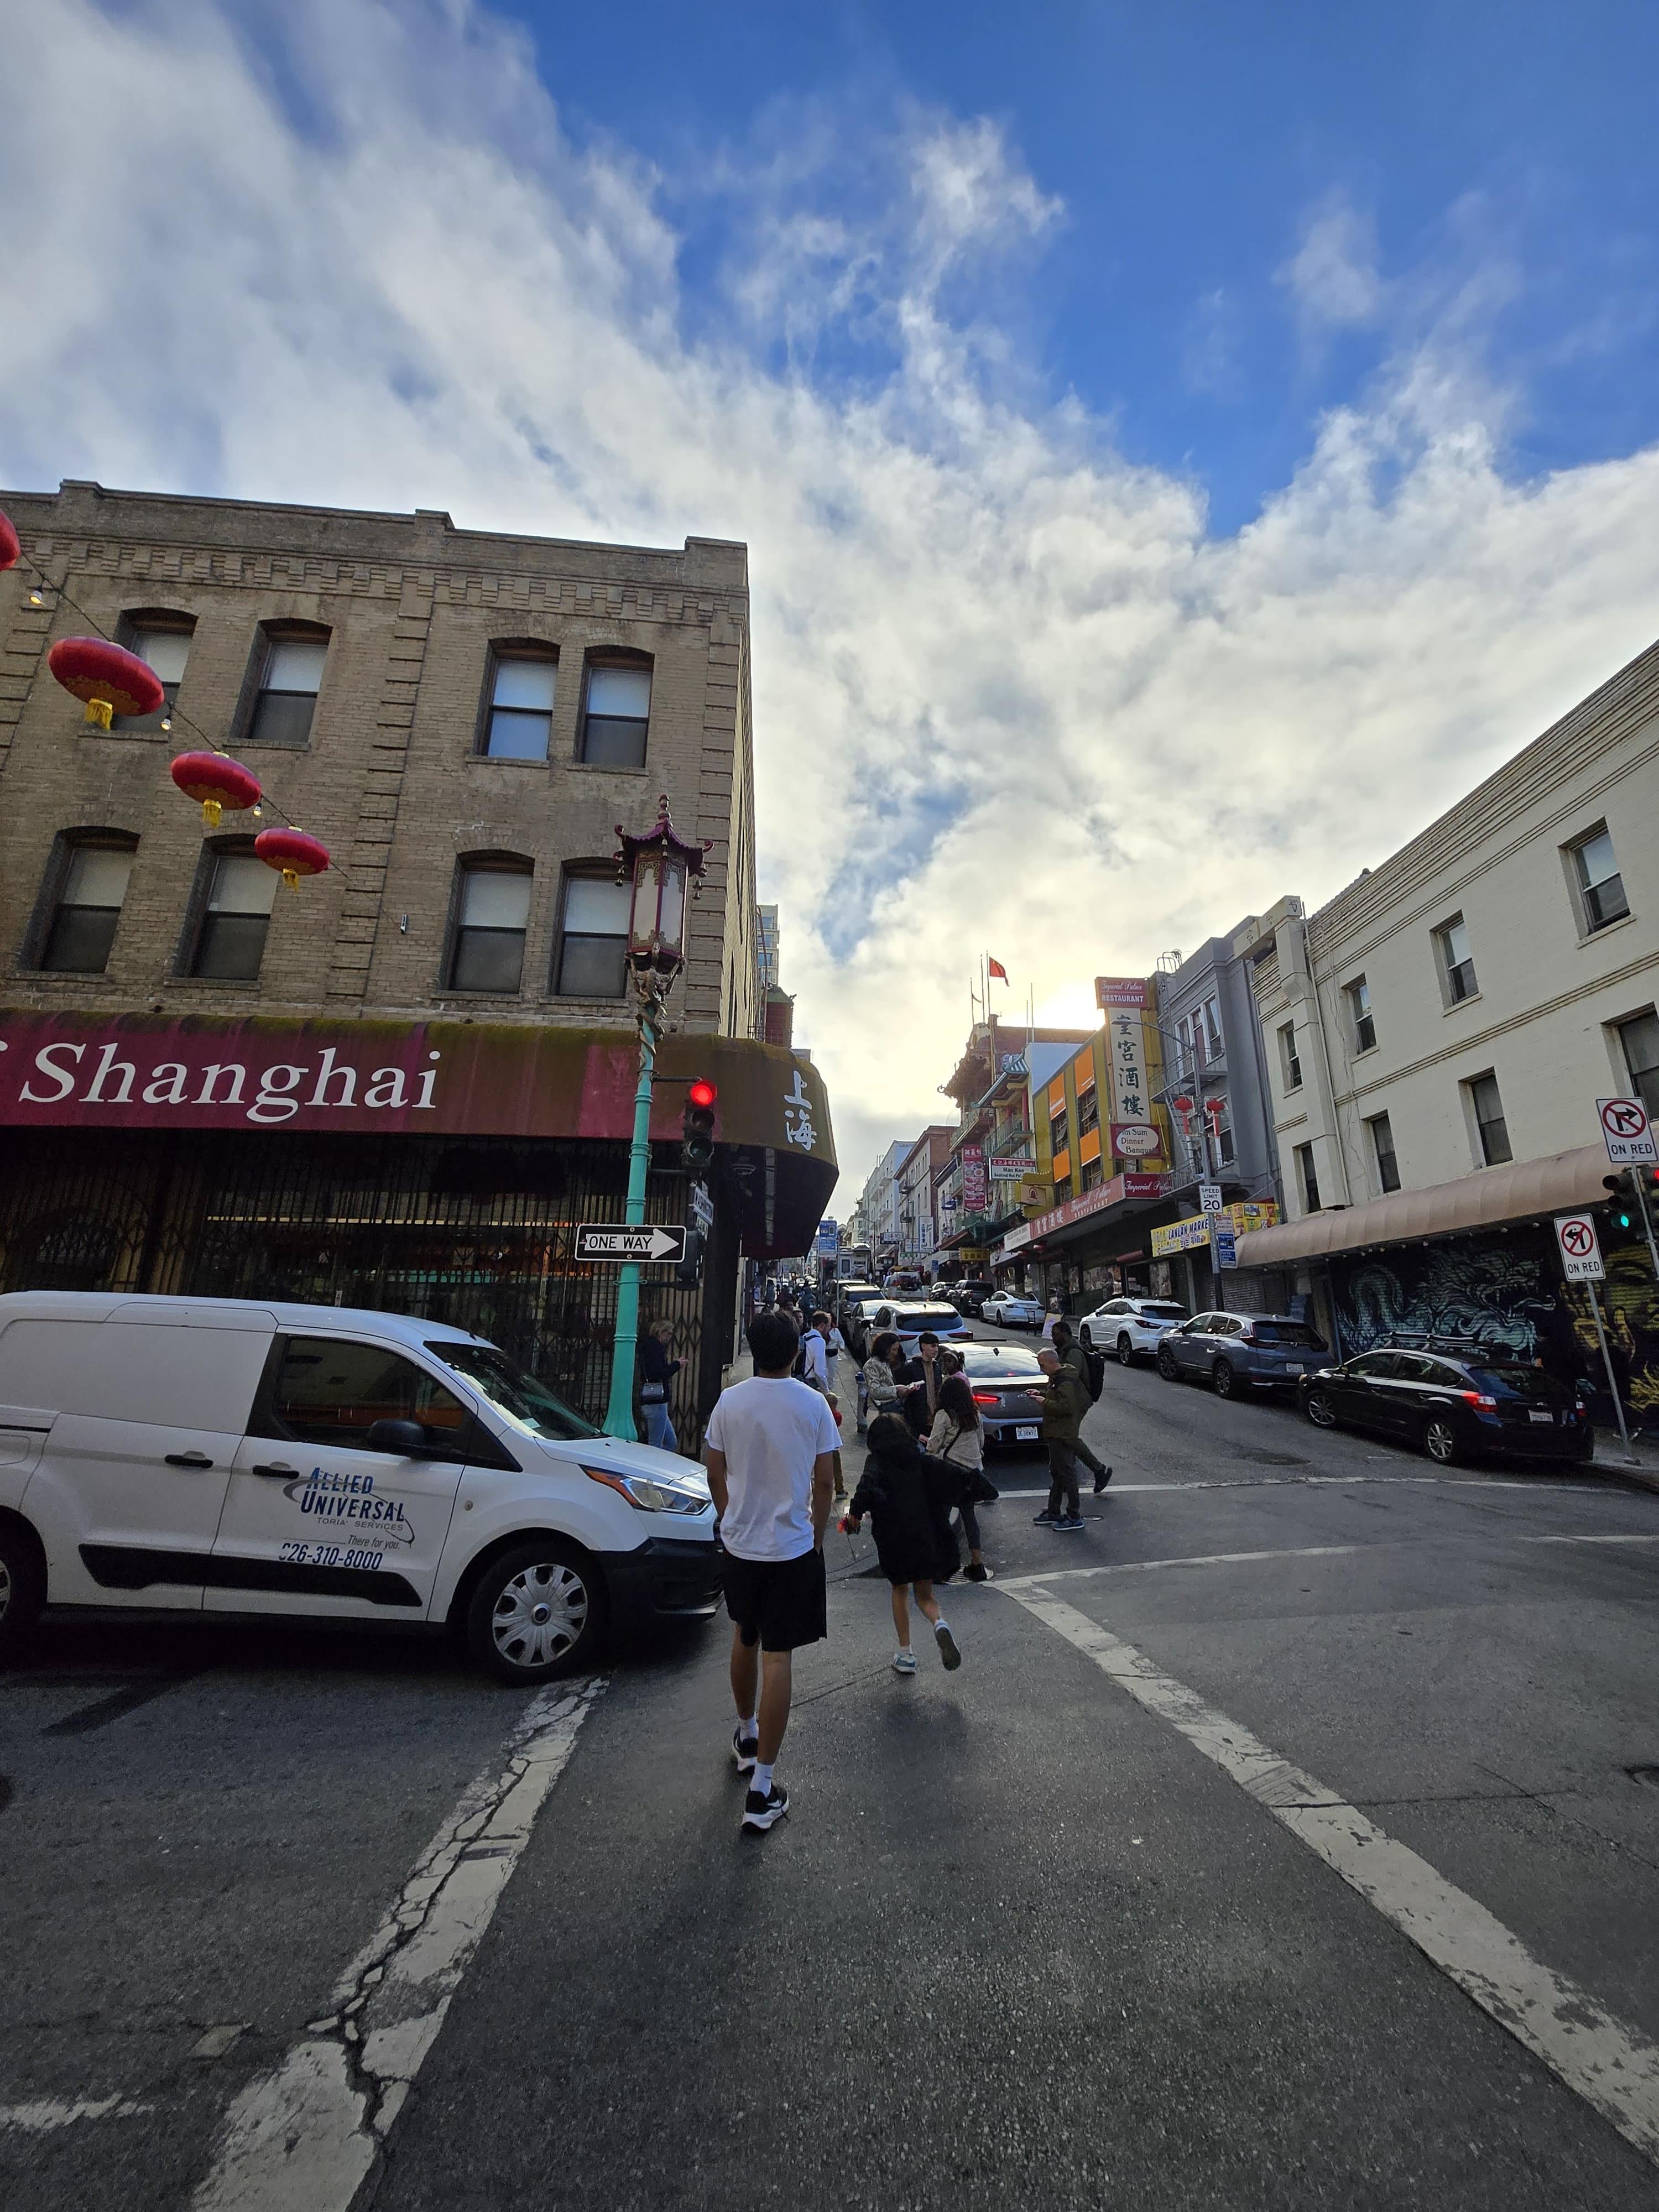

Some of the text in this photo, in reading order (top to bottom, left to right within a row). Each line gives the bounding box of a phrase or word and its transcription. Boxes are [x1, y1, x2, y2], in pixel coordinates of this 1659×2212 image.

[1100, 980, 1142, 992] Imperial Palace
[1102, 994, 1144, 1003] RESTAURANT
[19, 1042, 442, 1123] Shanghai
[784, 1070, 817, 1151] 上海
[1611, 1143, 1652, 1155] ON RED
[1125, 1180, 1153, 1193] Imperial
[1203, 1199, 1220, 1210] 20
[1168, 1224, 1188, 1240] LANLAN
[1189, 1218, 1209, 1234] MARKE
[589, 1235, 653, 1250] ONE WAY
[1567, 1261, 1600, 1274] ON RED
[306, 1467, 374, 1494] ALLIED
[300, 1490, 405, 1522] UNIVERSAL
[354, 1521, 404, 1531] SERVICES
[347, 1535, 400, 1551] There for you.
